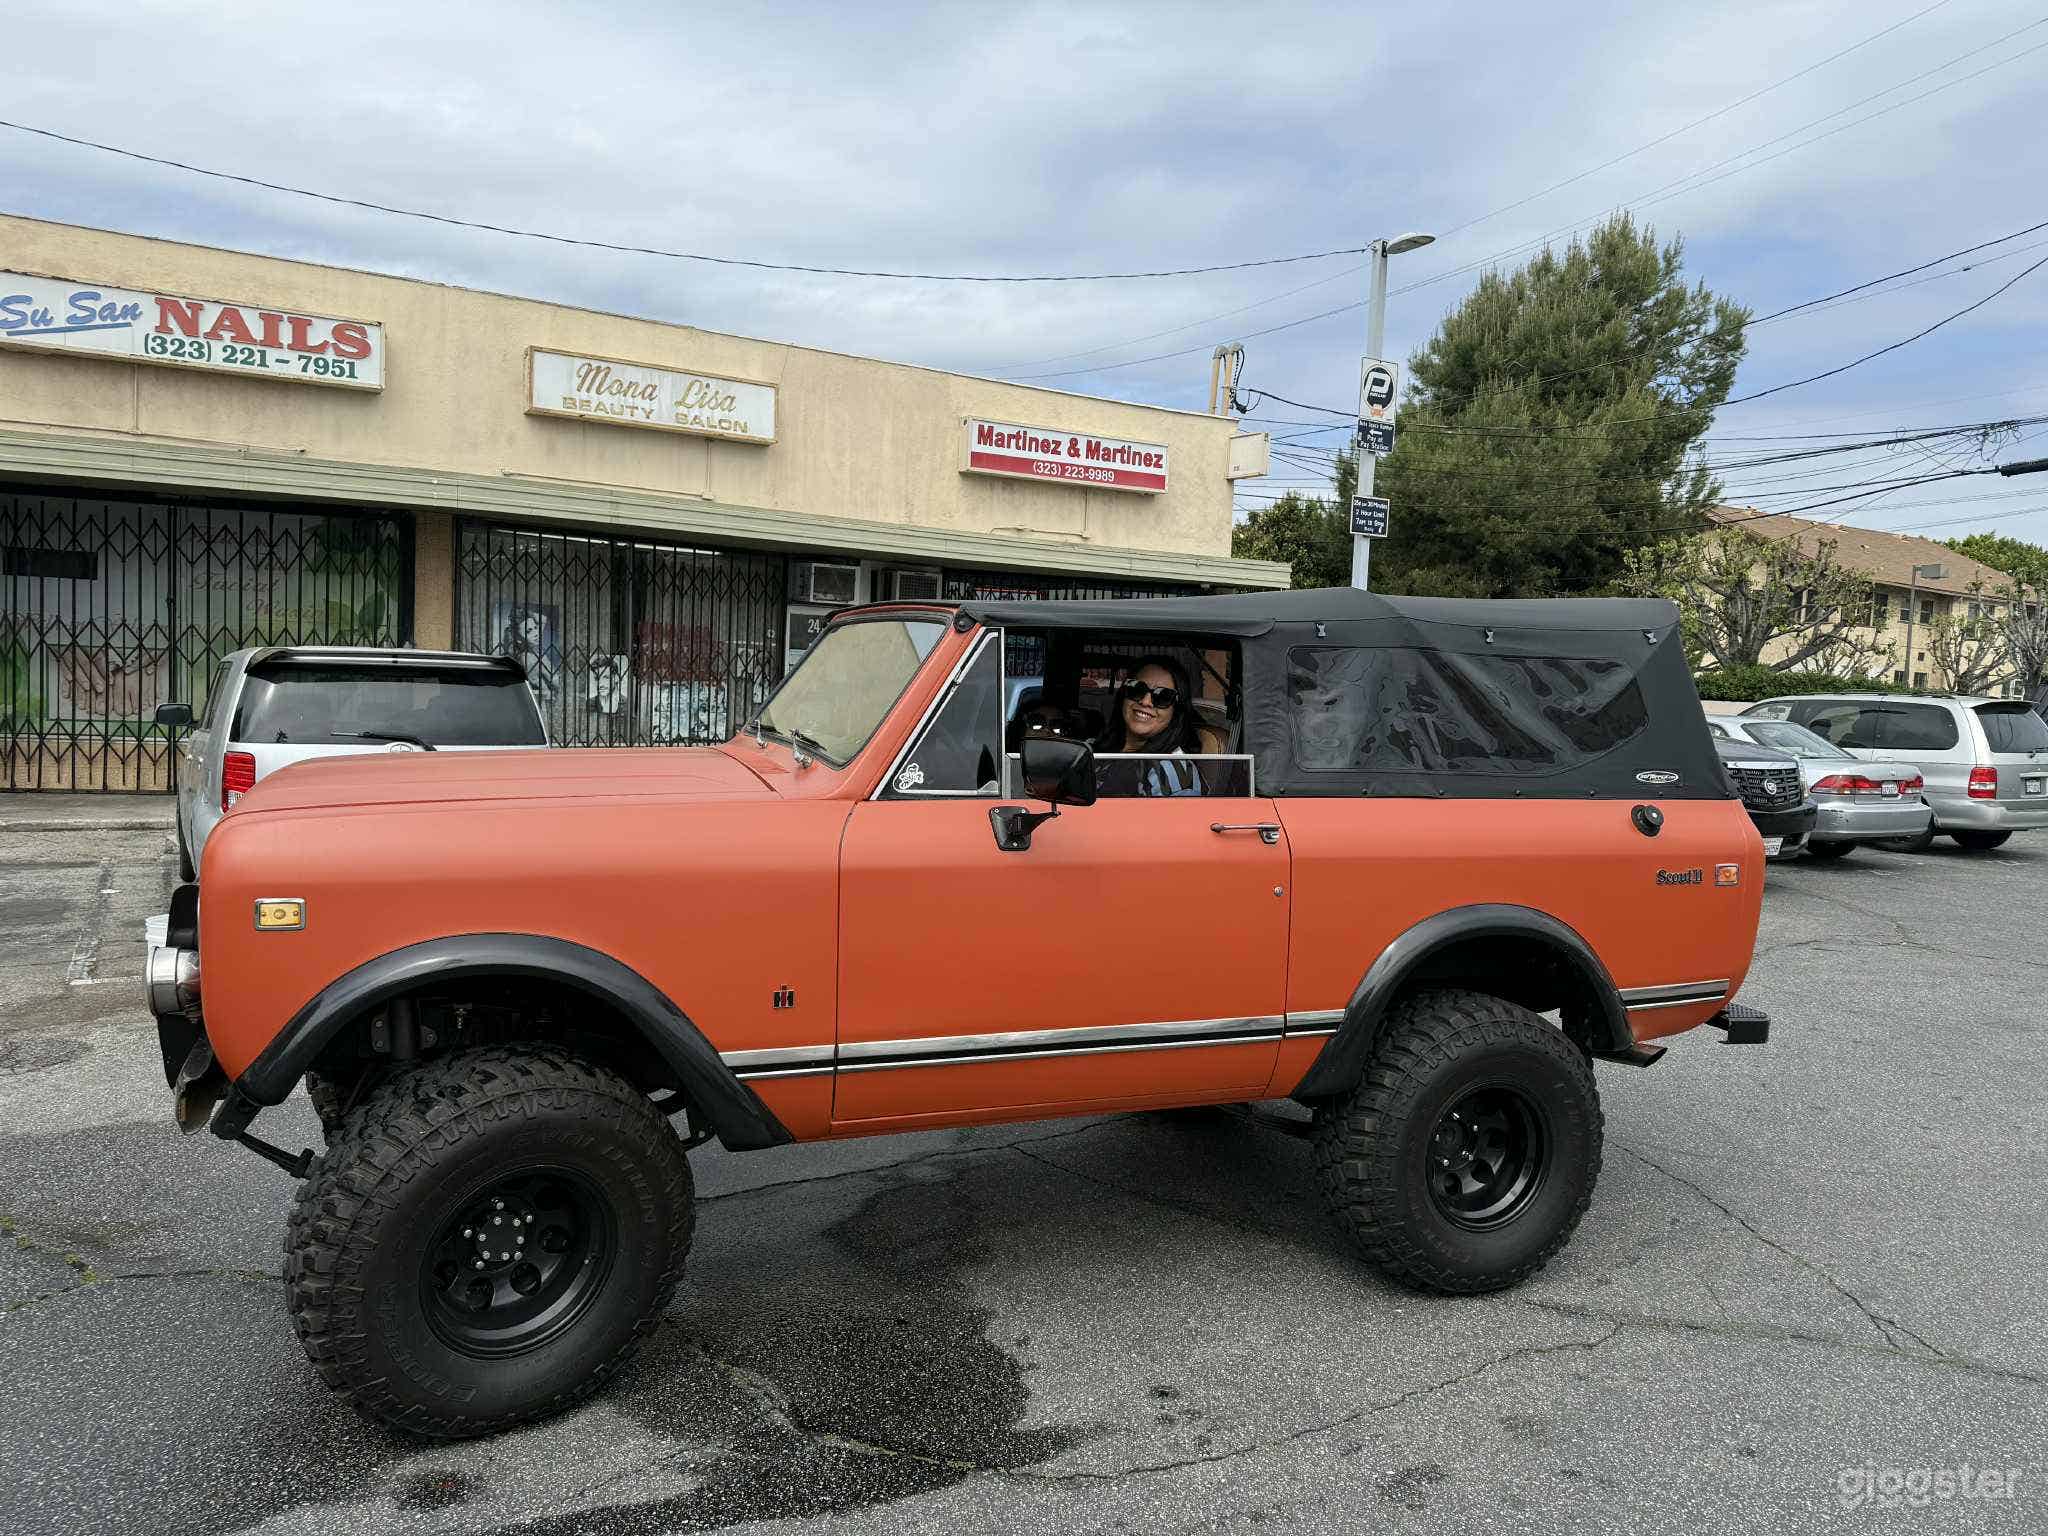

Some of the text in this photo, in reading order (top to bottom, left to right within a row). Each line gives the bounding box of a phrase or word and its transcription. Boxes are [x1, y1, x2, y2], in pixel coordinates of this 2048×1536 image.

[0, 291, 143, 328] Su San
[154, 296, 373, 360] NAILS
[144, 332, 213, 363] (323)
[576, 362, 737, 413] Mona Lisa
[562, 397, 748, 433] BEAUTY SALON
[977, 424, 1164, 469] Martinez & Martinez
[1033, 461, 1115, 482] (323) 223-9989
[1657, 868, 1691, 885] Scout
